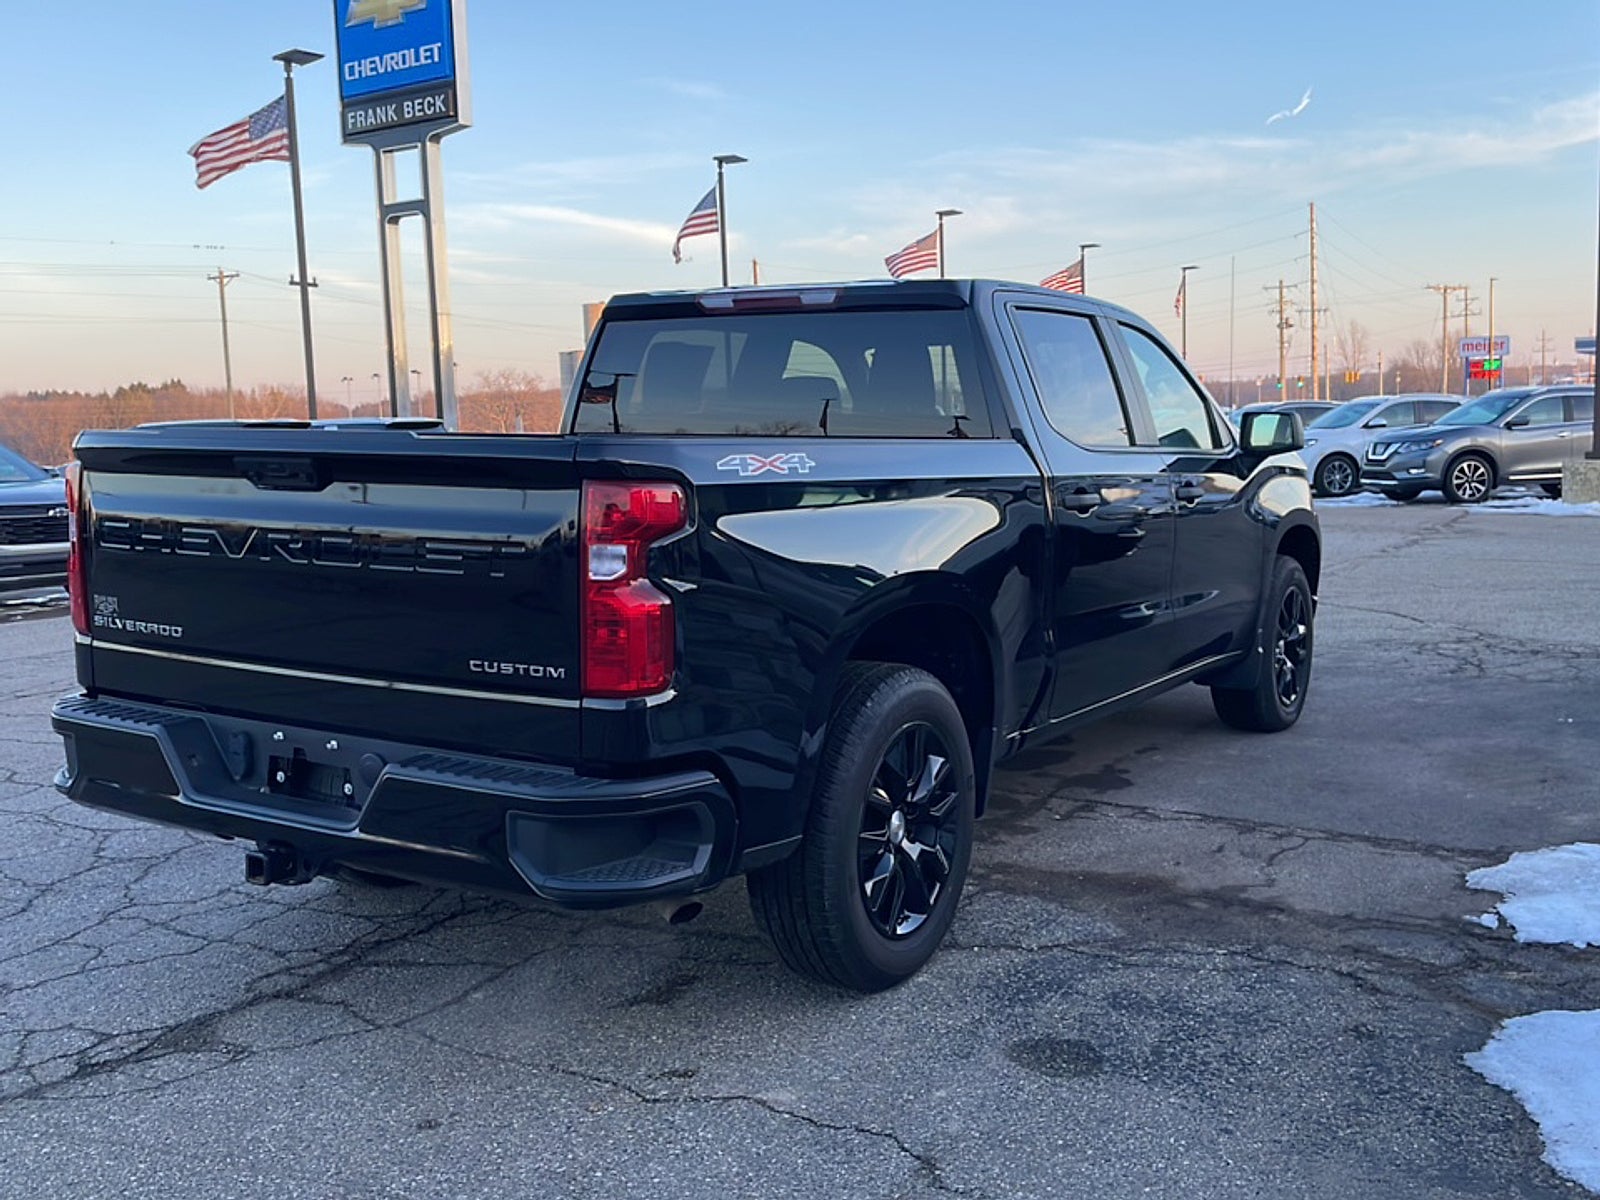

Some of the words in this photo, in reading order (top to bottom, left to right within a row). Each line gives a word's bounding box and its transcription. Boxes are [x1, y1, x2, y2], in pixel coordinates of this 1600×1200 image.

[344, 42, 442, 81] CHEVROLET
[347, 104, 397, 129] FRANK
[403, 94, 446, 119] BECK
[99, 520, 527, 577] CHEVROLET
[93, 614, 183, 638] SILVERADO
[469, 659, 565, 679] CUSTOM
